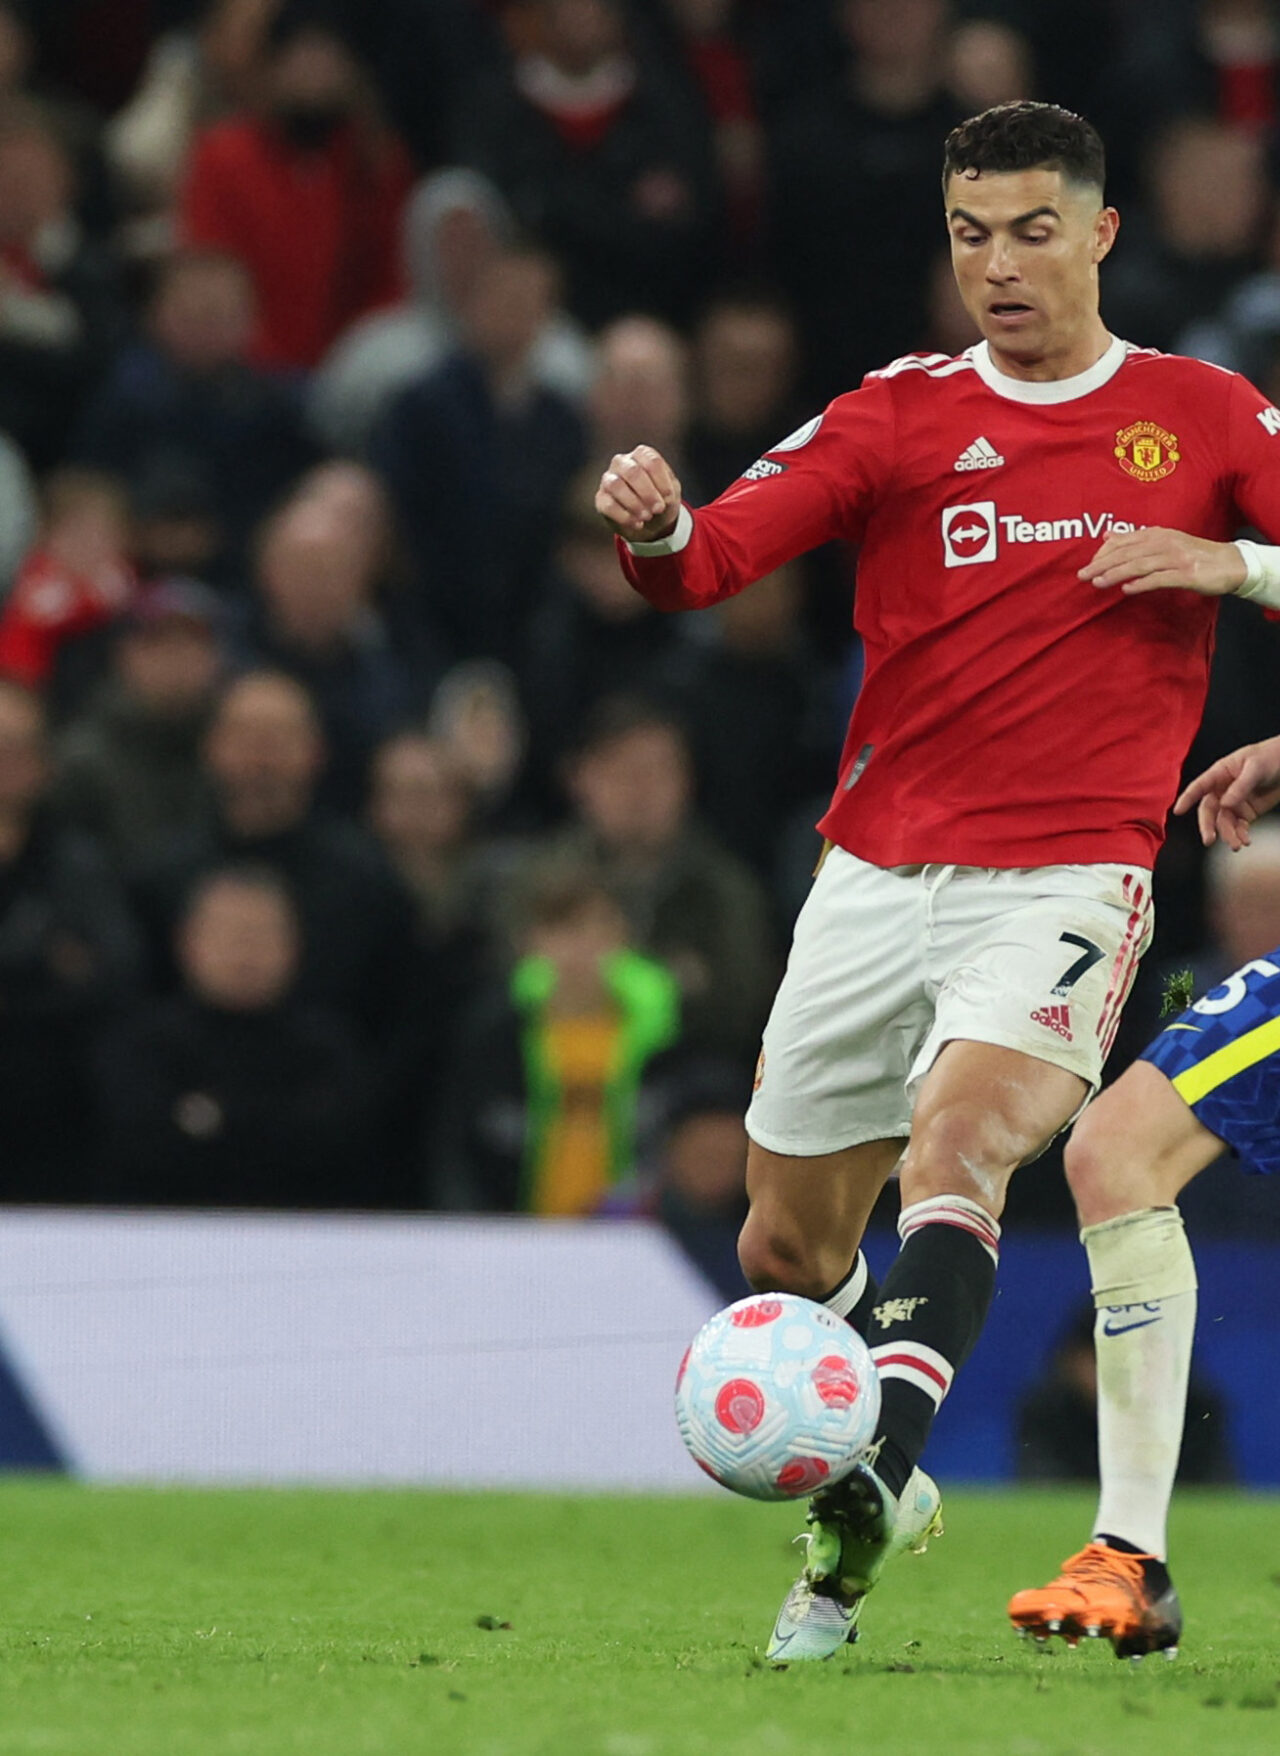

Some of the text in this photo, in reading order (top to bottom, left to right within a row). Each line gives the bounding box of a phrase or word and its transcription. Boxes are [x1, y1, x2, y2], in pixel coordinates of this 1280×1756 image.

[954, 455, 1005, 472] adidas
[1050, 931, 1106, 997] 7
[1030, 1010, 1073, 1042] adidas
